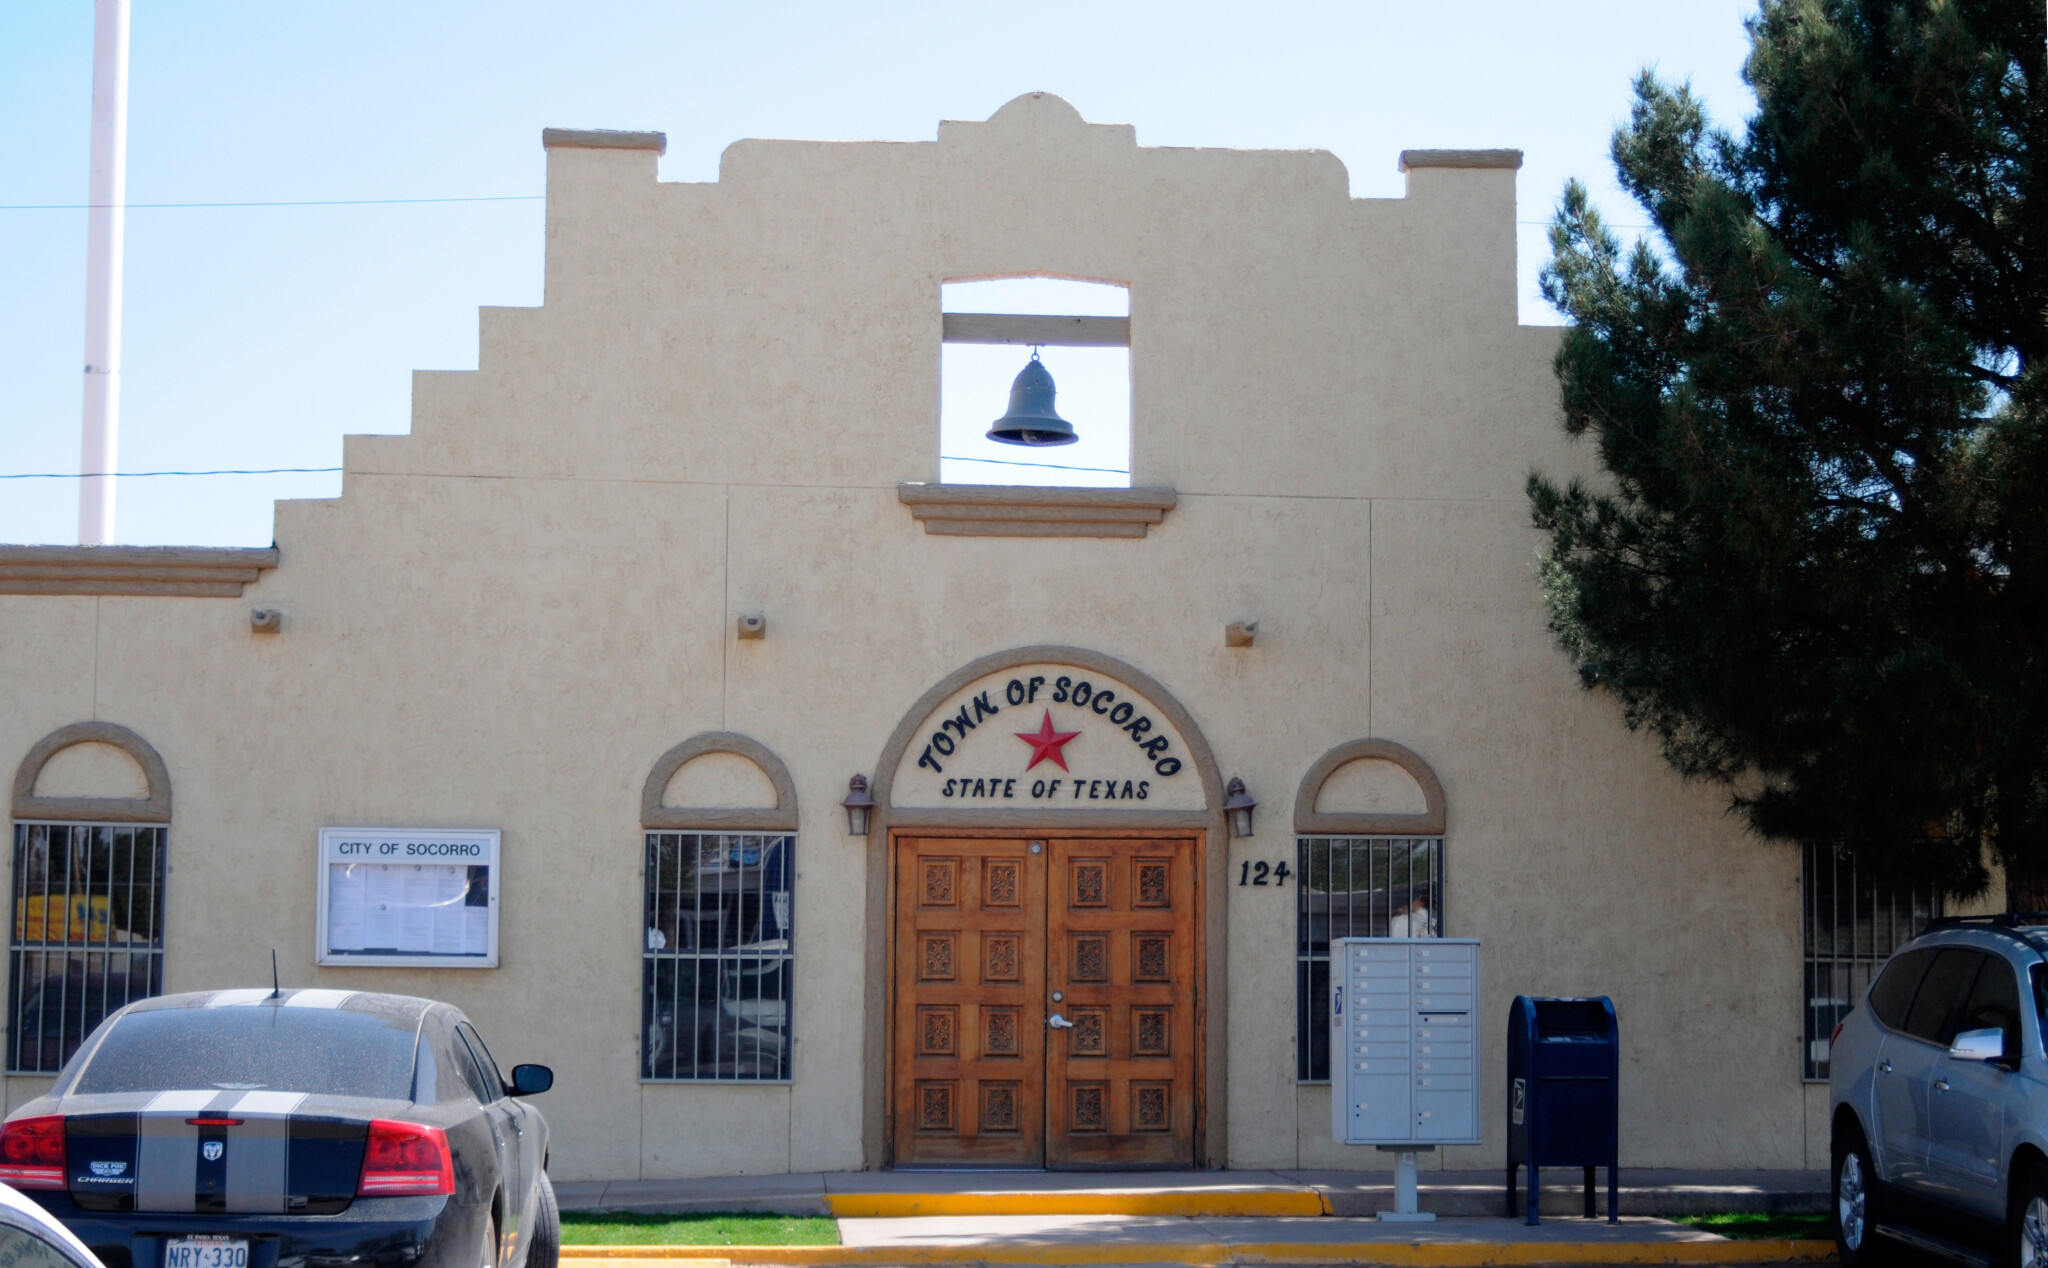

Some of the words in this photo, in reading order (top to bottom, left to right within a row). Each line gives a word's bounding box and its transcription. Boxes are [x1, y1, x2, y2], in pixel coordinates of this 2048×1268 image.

[918, 690, 999, 774] TOWN
[1006, 675, 1046, 706] OF
[1052, 676, 1182, 777] SOCORRO
[942, 778, 1017, 798] STATE
[1031, 778, 1062, 799] OF
[1073, 779, 1150, 800] TEXAS
[339, 842, 373, 855] CITY
[379, 842, 400, 855] OF
[406, 843, 481, 857] SOCORRO
[1239, 860, 1291, 887] 124
[167, 1246, 202, 1268] NRY
[212, 1247, 247, 1268] 330
